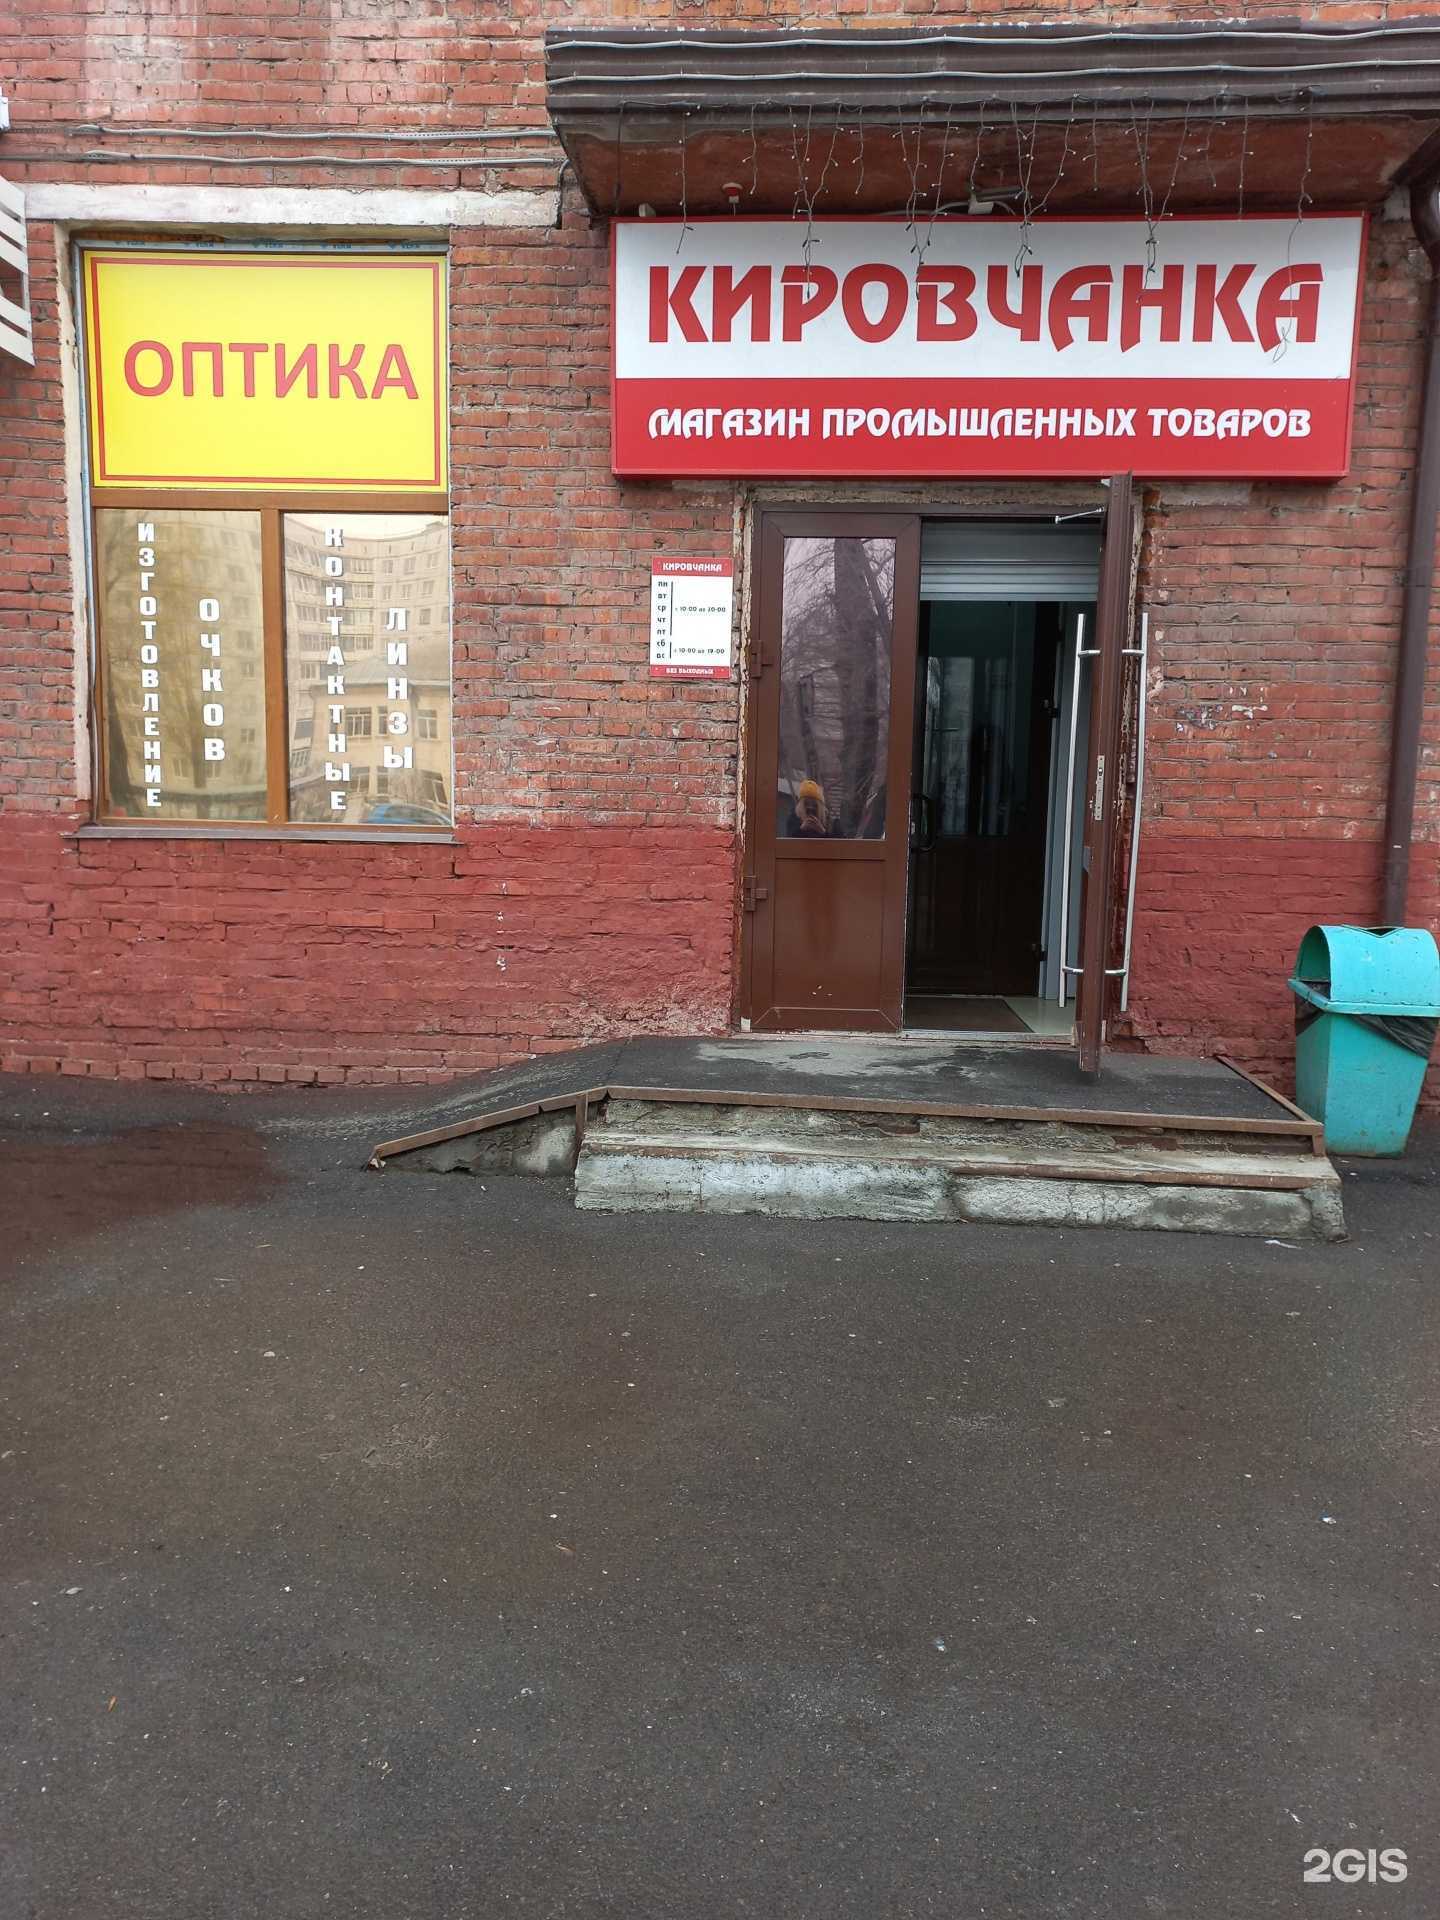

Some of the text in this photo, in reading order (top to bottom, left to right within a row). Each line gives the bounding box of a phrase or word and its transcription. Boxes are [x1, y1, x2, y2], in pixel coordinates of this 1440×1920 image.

[124, 340, 419, 399] ОПТИКА
[649, 263, 1324, 353] КИРОВЧАНКА
[648, 408, 1311, 440] МАГАЗИН ПРОМЫШЛЕННЫХ ТОВАРОВ
[662, 562, 722, 572] КИРОВЧАНКА
[137, 522, 162, 807] ИЗГОТОВЛЕНИЕ
[199, 598, 226, 761] ОЧКОВ
[324, 528, 351, 810] КОНТАКТНЫЕ
[383, 607, 413, 769] ЛИНЗЫ
